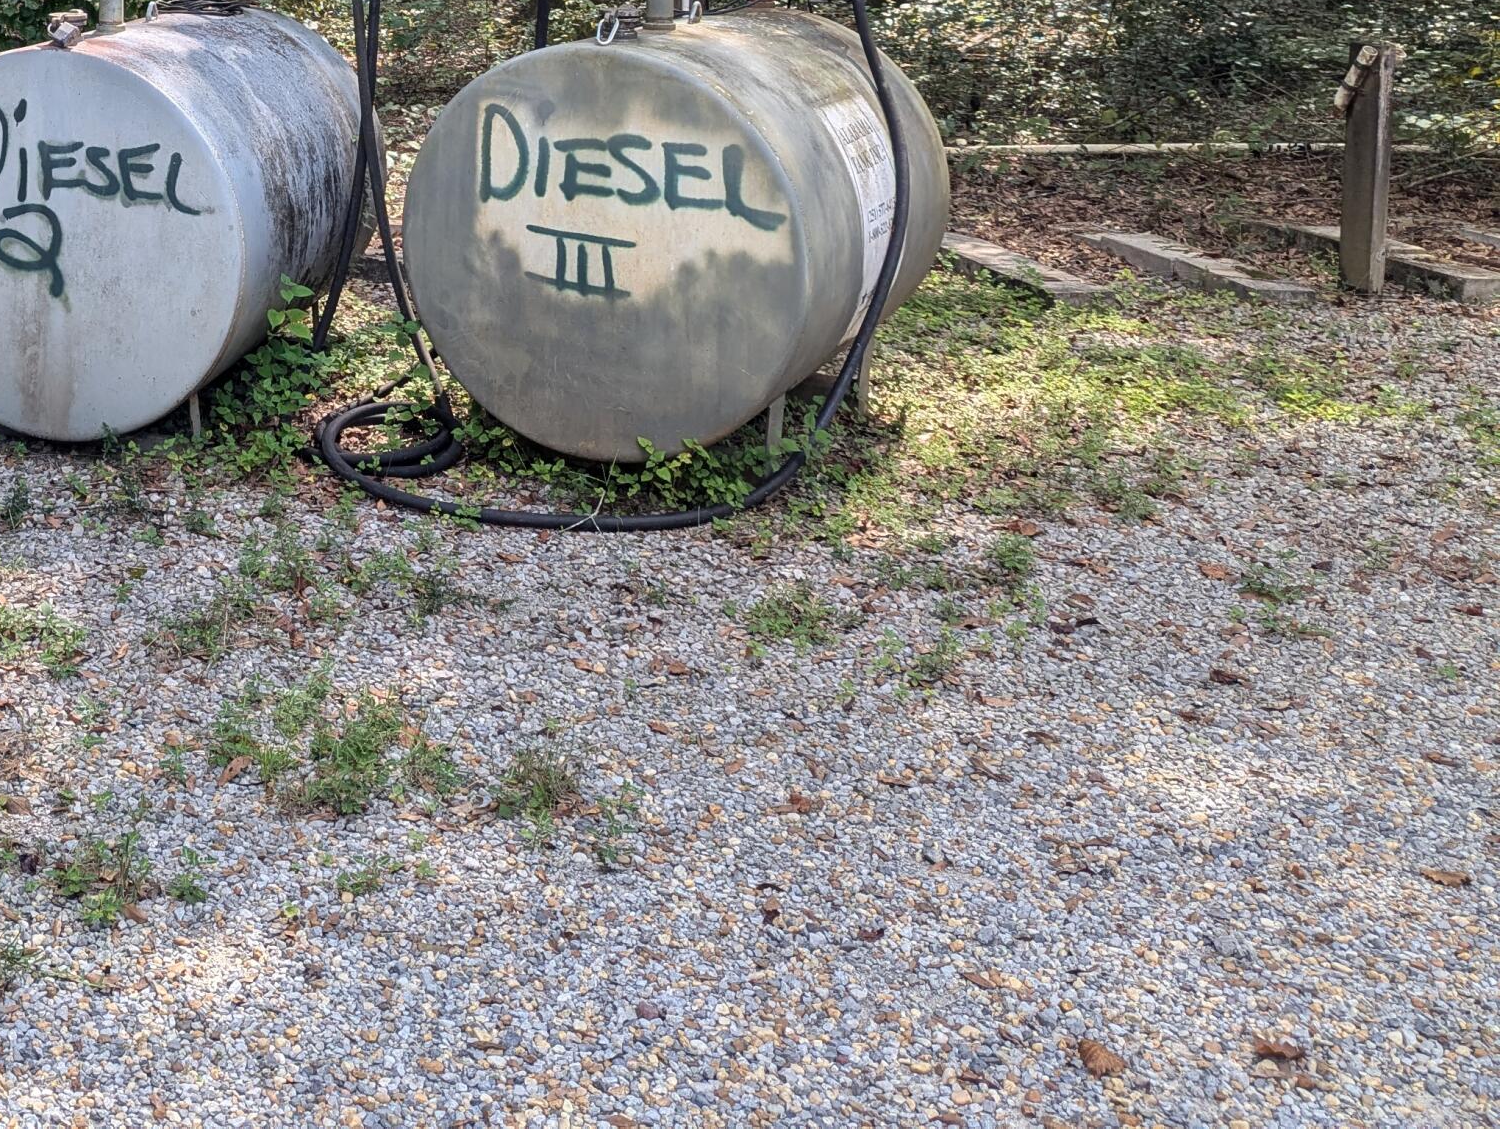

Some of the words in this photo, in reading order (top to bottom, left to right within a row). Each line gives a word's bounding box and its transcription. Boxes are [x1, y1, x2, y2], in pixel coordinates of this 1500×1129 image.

[837, 118, 873, 145] ALABAMA
[851, 150, 874, 174] TANK
[525, 224, 636, 297] III
